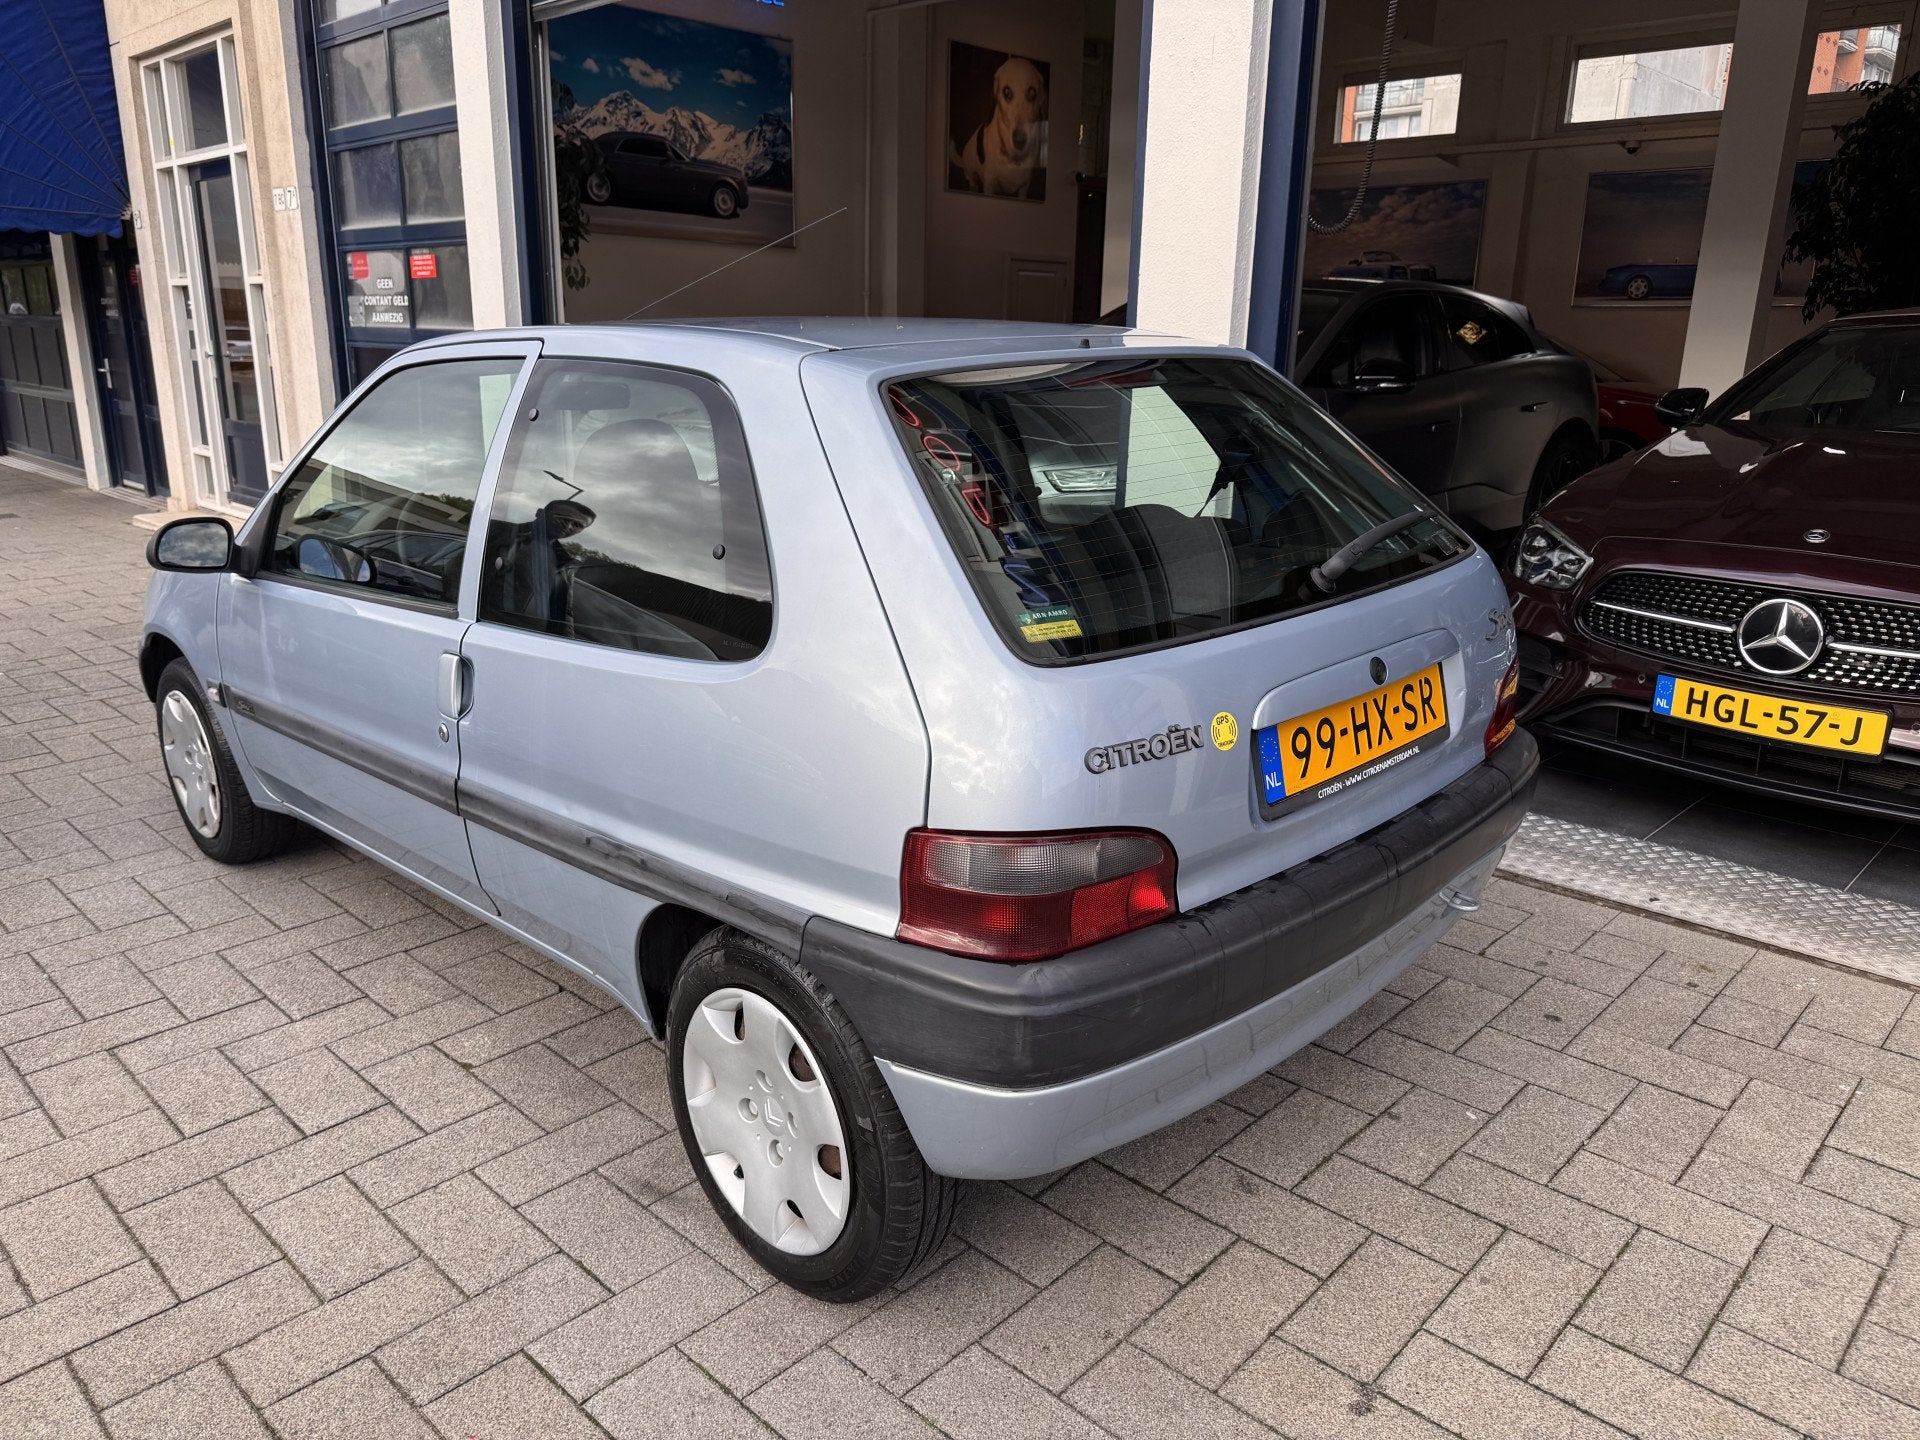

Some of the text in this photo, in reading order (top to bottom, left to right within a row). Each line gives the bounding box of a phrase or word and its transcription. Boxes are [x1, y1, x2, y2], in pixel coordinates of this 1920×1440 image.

[376, 278, 394, 289] GEEN
[364, 295, 409, 306] CONTANT GELD
[371, 312, 404, 323] AANWEZIG
[1655, 697, 1670, 709] NL
[1215, 715, 1230, 725] GPS
[1685, 686, 1864, 746] HGL-57-J
[1291, 676, 1437, 779] 99-HX-SR
[1084, 723, 1204, 774] CITROËN
[1344, 745, 1420, 787] WWW.CITROENAMSTERDAM.NL
[1265, 772, 1281, 790] NL
